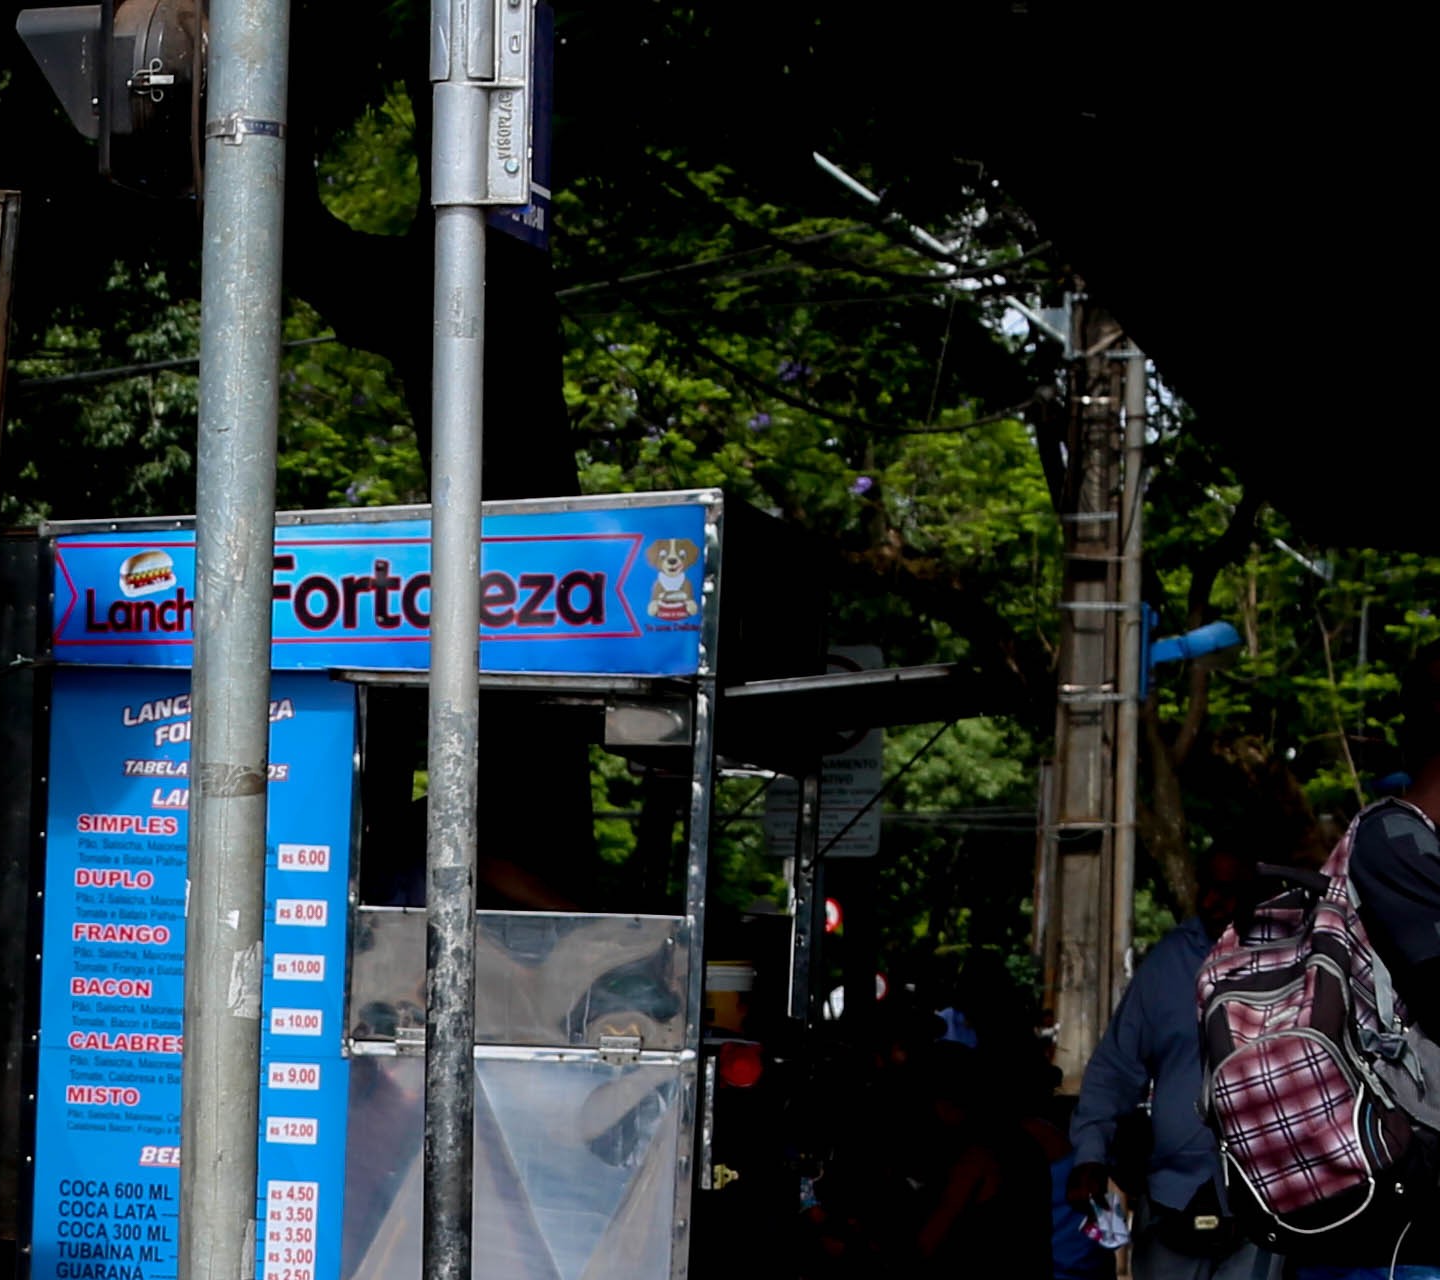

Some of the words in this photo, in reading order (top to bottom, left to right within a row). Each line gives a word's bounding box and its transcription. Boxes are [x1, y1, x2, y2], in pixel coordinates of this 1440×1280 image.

[85, 587, 194, 633] Lanch
[123, 694, 191, 726] LANC
[77, 814, 178, 835] SIMPLES
[298, 849, 326, 866] 6,00
[75, 870, 154, 889] DUPLO
[295, 905, 323, 921] 8,00
[73, 924, 169, 944] FRANGO
[291, 959, 320, 975] 10,00
[71, 978, 151, 998] BACON
[288, 1014, 319, 1029] 10,00
[288, 1068, 316, 1085] 9,00
[66, 1086, 140, 1105] MISTO
[284, 1123, 313, 1138] 12,00
[59, 1180, 110, 1198] COCA
[114, 1182, 144, 1199] 600
[149, 1184, 173, 1200] ML
[58, 1200, 109, 1218] COCA
[114, 1202, 157, 1220] LATA
[57, 1221, 108, 1239] COCA
[112, 1223, 142, 1241] 300
[147, 1225, 171, 1242] ML
[139, 1244, 164, 1262] ML
[284, 1247, 313, 1265] 3,00
